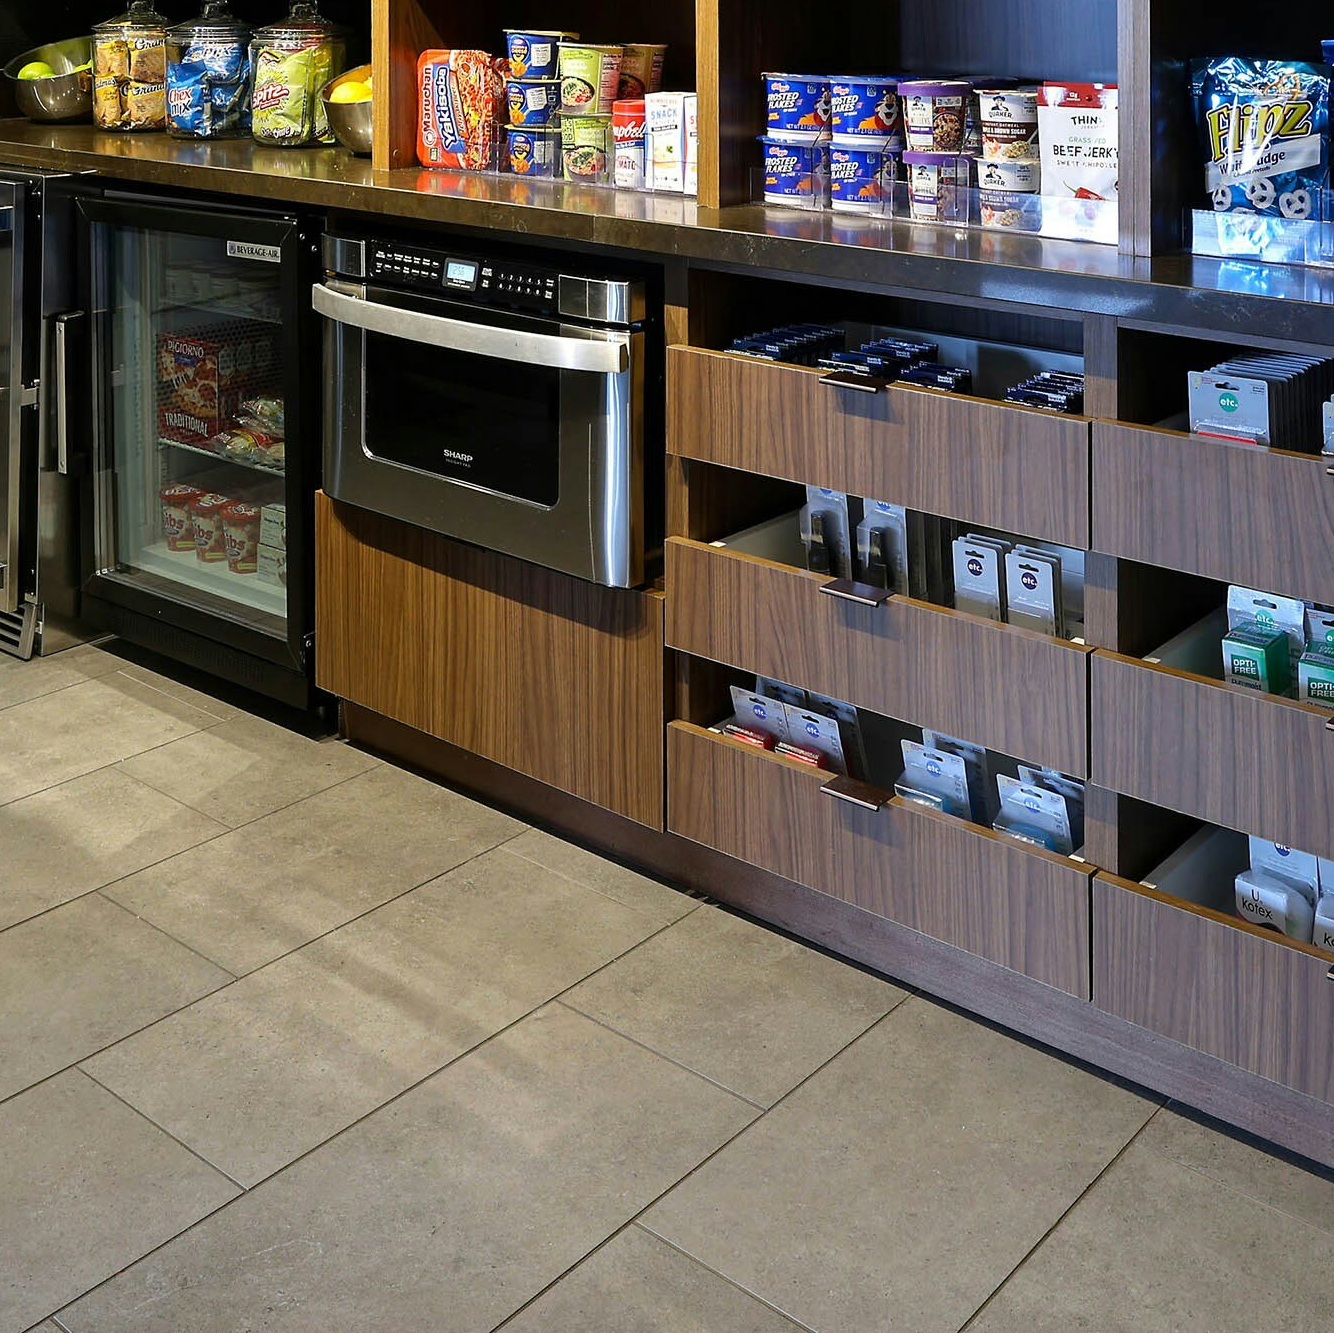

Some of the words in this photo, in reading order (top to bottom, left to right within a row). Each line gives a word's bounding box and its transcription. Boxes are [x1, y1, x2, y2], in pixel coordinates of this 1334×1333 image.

[168, 88, 192, 103] Chex
[422, 68, 431, 132] Maruchan
[436, 66, 457, 148] Yakisoba
[1220, 397, 1238, 408] etc.
[165, 412, 208, 438] TRADITIONAL
[443, 449, 473, 462] SHARP
[1234, 666, 1256, 675] FREE
[1311, 689, 1334, 698] FREE
[1241, 895, 1273, 920] kotex
